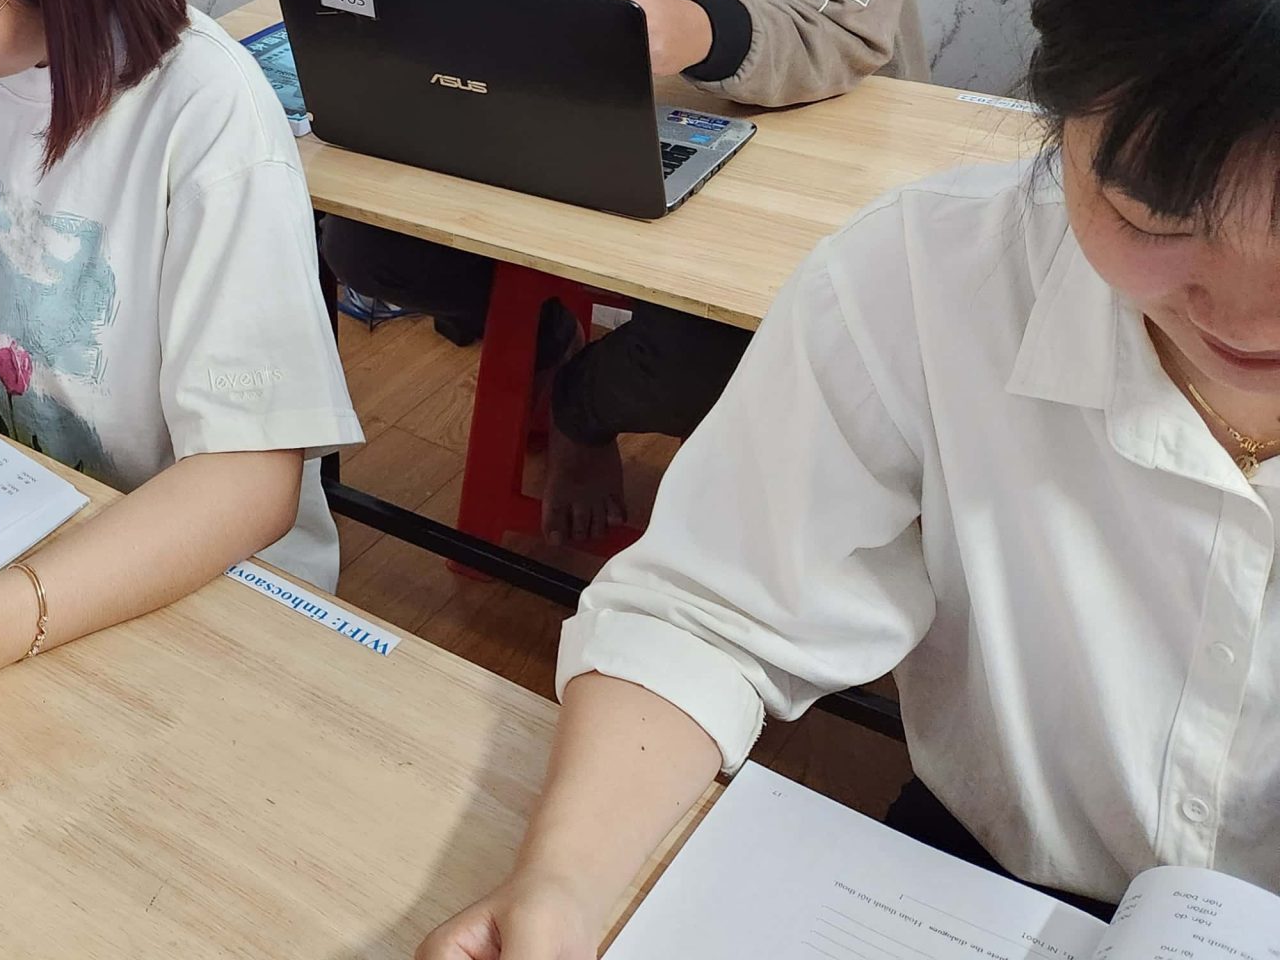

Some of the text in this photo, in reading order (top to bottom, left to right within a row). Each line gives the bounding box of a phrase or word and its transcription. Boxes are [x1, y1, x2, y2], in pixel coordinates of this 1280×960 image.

[430, 73, 488, 94] ASUS
[225, 565, 389, 656] WIFI: tinhocsaovi
